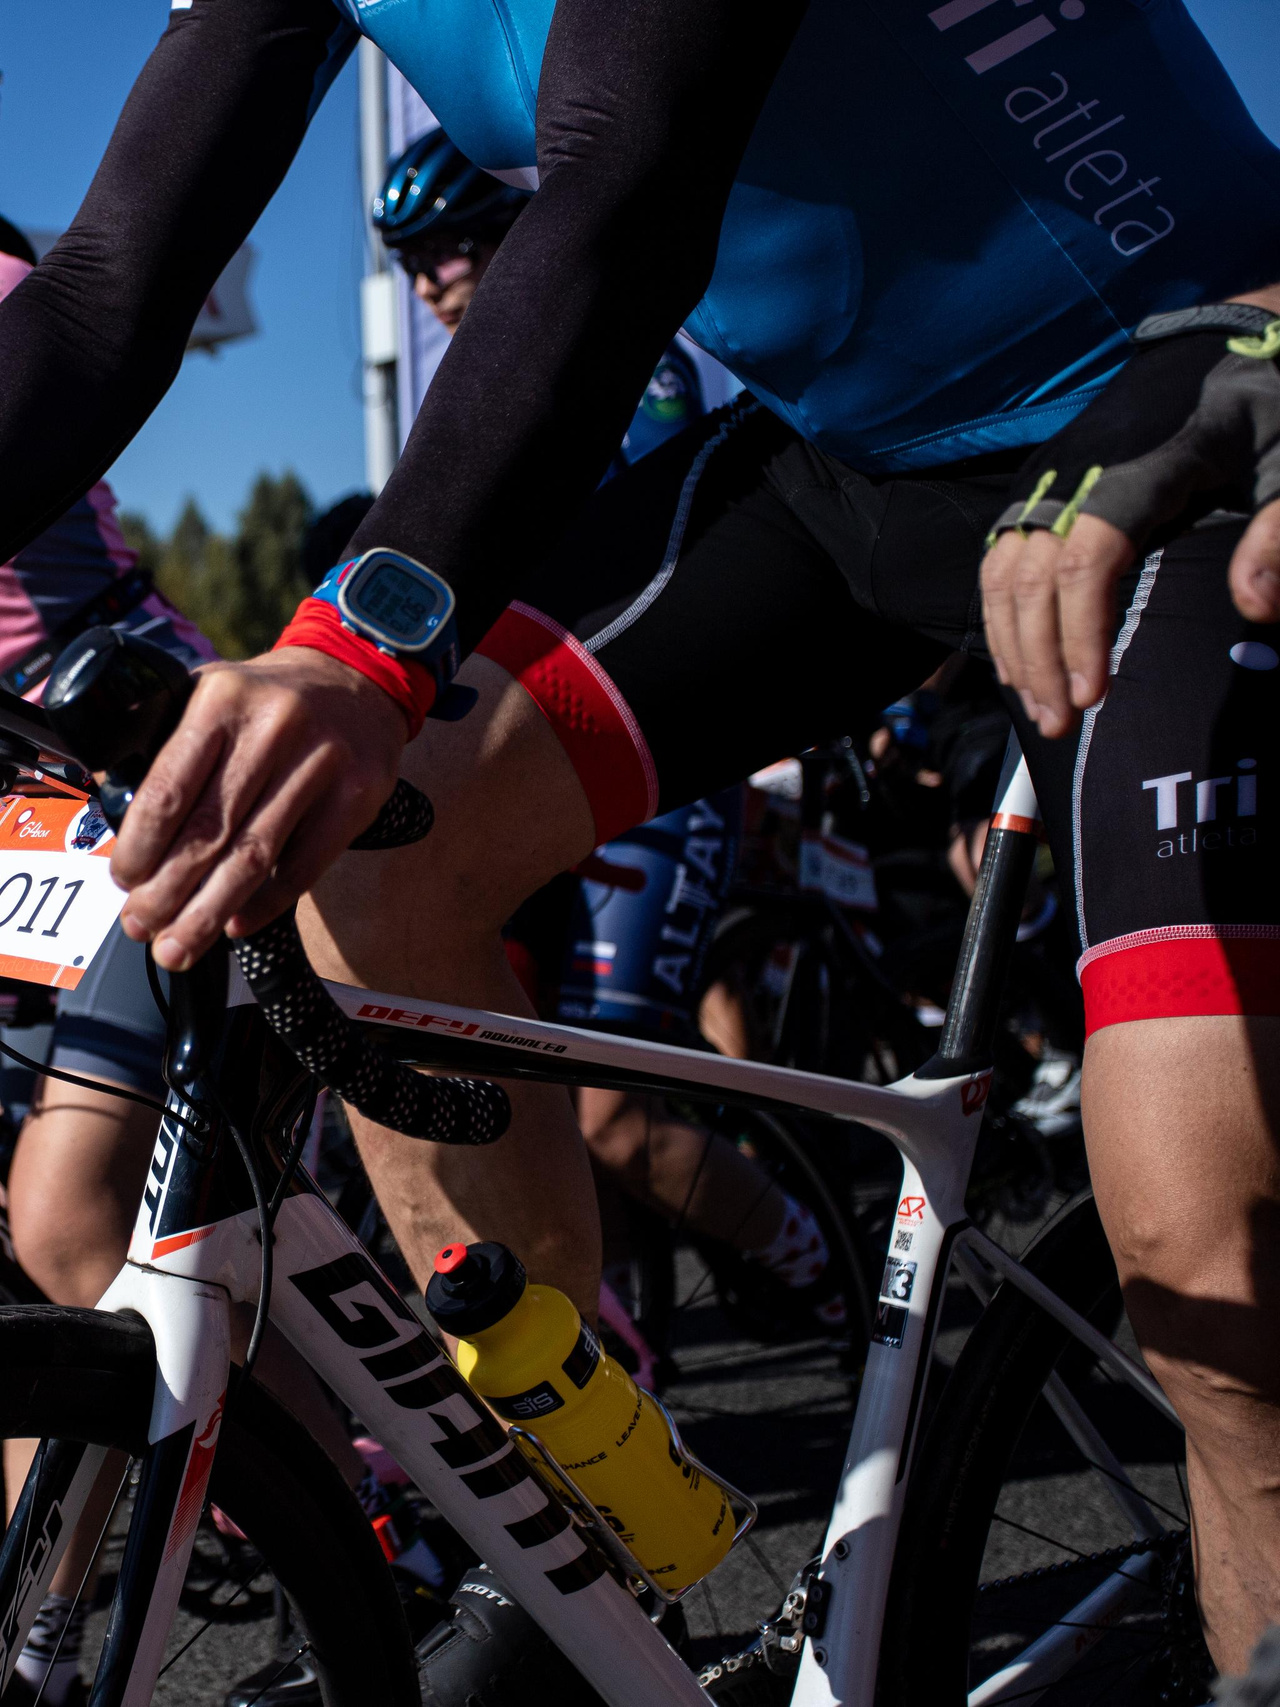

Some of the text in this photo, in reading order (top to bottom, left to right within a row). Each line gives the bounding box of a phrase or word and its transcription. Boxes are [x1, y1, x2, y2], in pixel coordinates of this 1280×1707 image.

[1004, 70, 1176, 257] atleta
[1141, 756, 1258, 831] Tri
[1156, 824, 1259, 859] atleta
[651, 795, 725, 999] ALTAY
[358, 1003, 569, 1054] DEFY ADVANCED
[287, 1250, 624, 1596] GIANT
[459, 1581, 514, 1608] SCOTT
